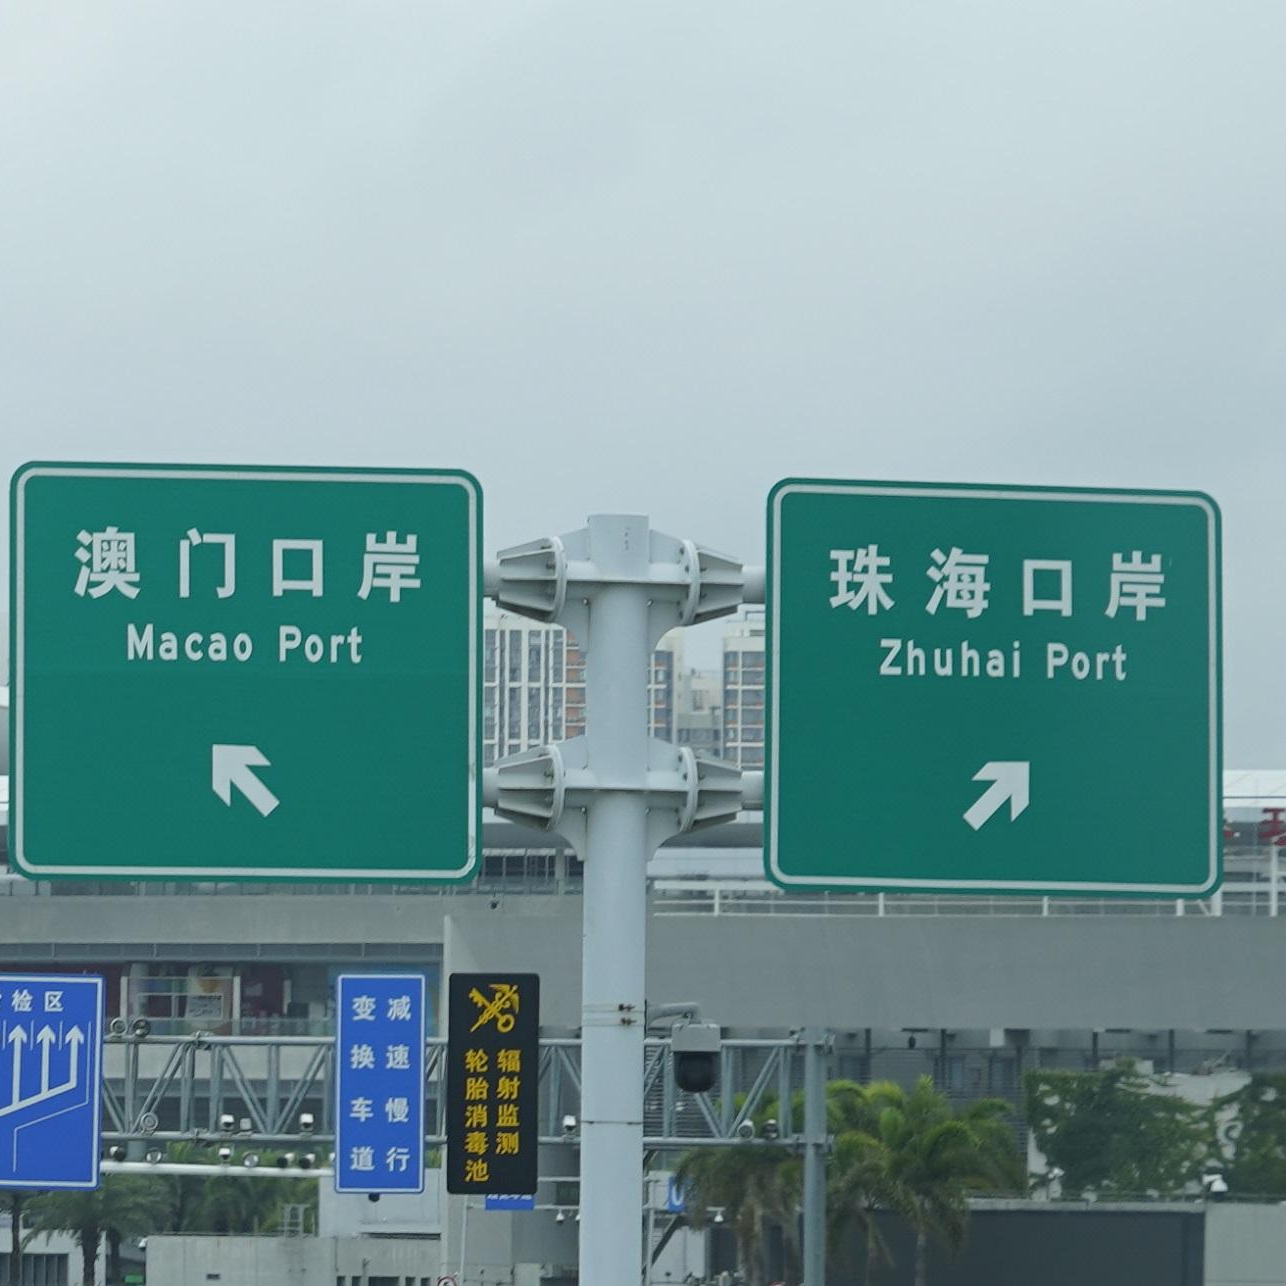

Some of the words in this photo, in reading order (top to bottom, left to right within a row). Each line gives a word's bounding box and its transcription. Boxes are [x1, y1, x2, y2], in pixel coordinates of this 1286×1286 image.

[73, 526, 422, 603] 澳门口岸
[828, 543, 1167, 621] 珠海口岸
[126, 623, 254, 663] Macao
[278, 625, 363, 664] Port
[879, 639, 1022, 678] Zhuhai
[1046, 642, 1128, 681] Port
[349, 995, 376, 1172] 变换车道
[385, 995, 411, 1172] 减速慢行
[464, 1047, 490, 1183] 轮胎消毒池
[495, 1047, 522, 1157] 辐射监测
